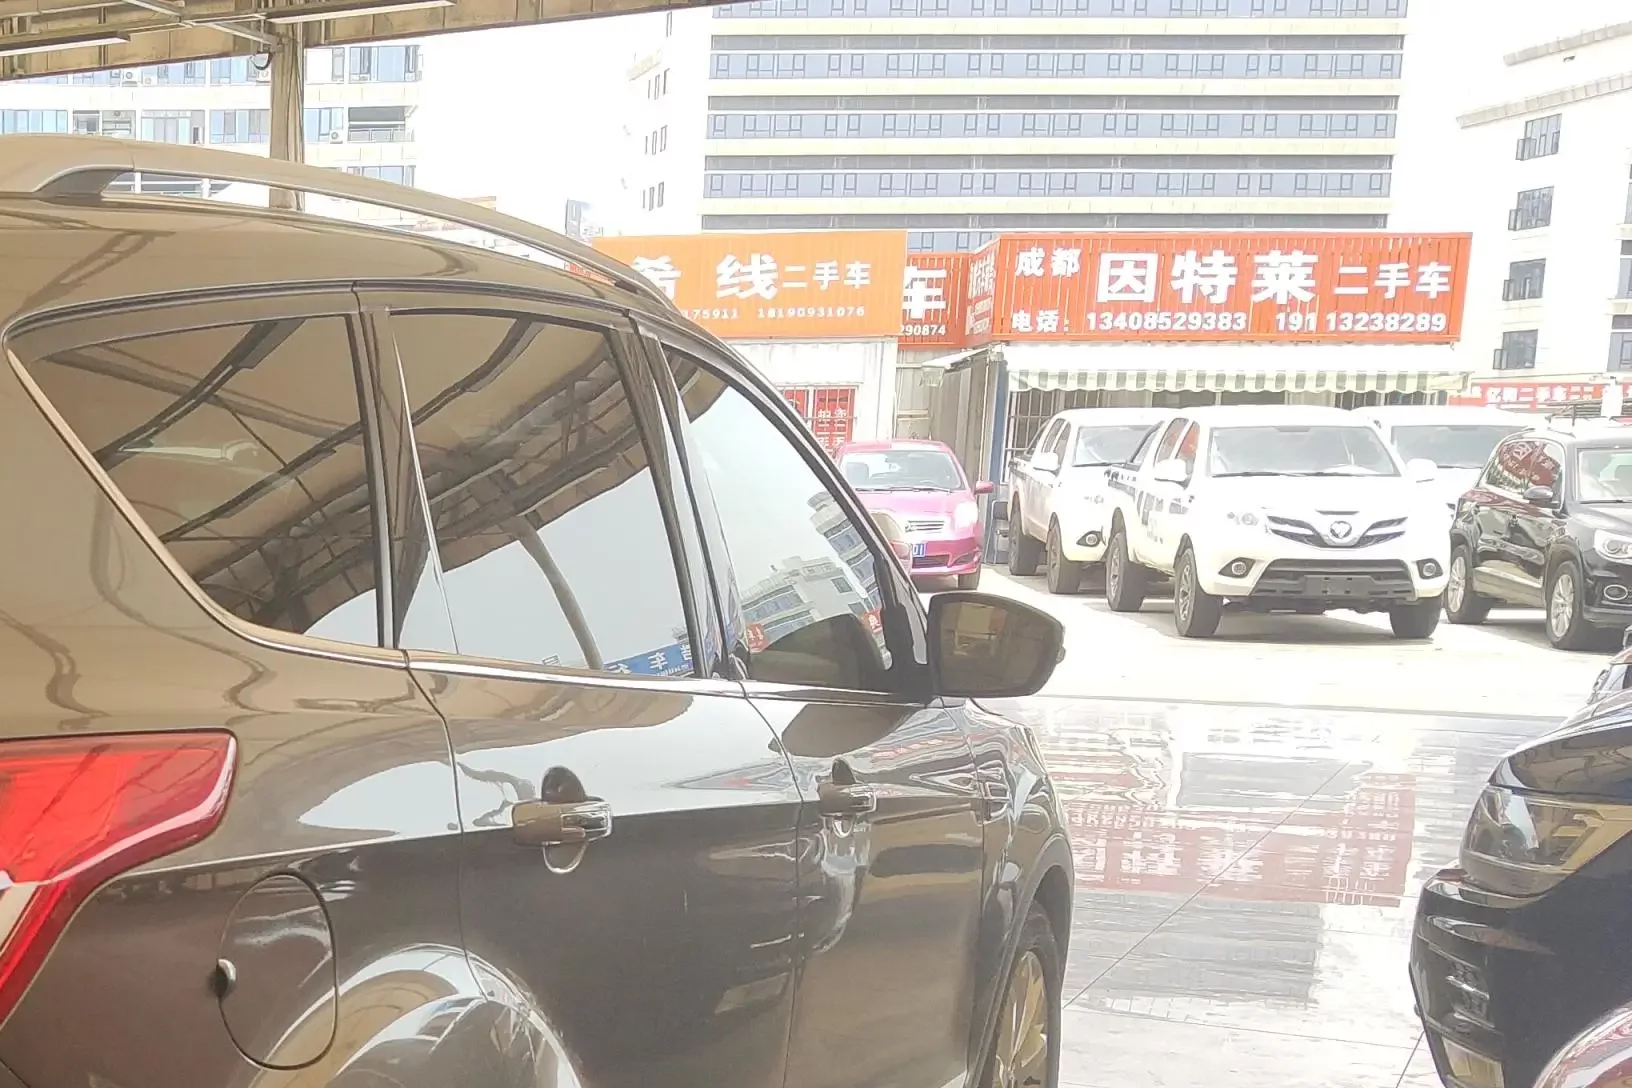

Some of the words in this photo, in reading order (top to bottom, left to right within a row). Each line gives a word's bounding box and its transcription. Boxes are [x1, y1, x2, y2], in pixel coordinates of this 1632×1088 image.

[782, 260, 871, 290] 二手车
[1015, 247, 1081, 277] 成都
[1096, 249, 1318, 305] 因特莱
[1334, 261, 1451, 299] 二手车
[1087, 311, 1248, 331] 13408529383
